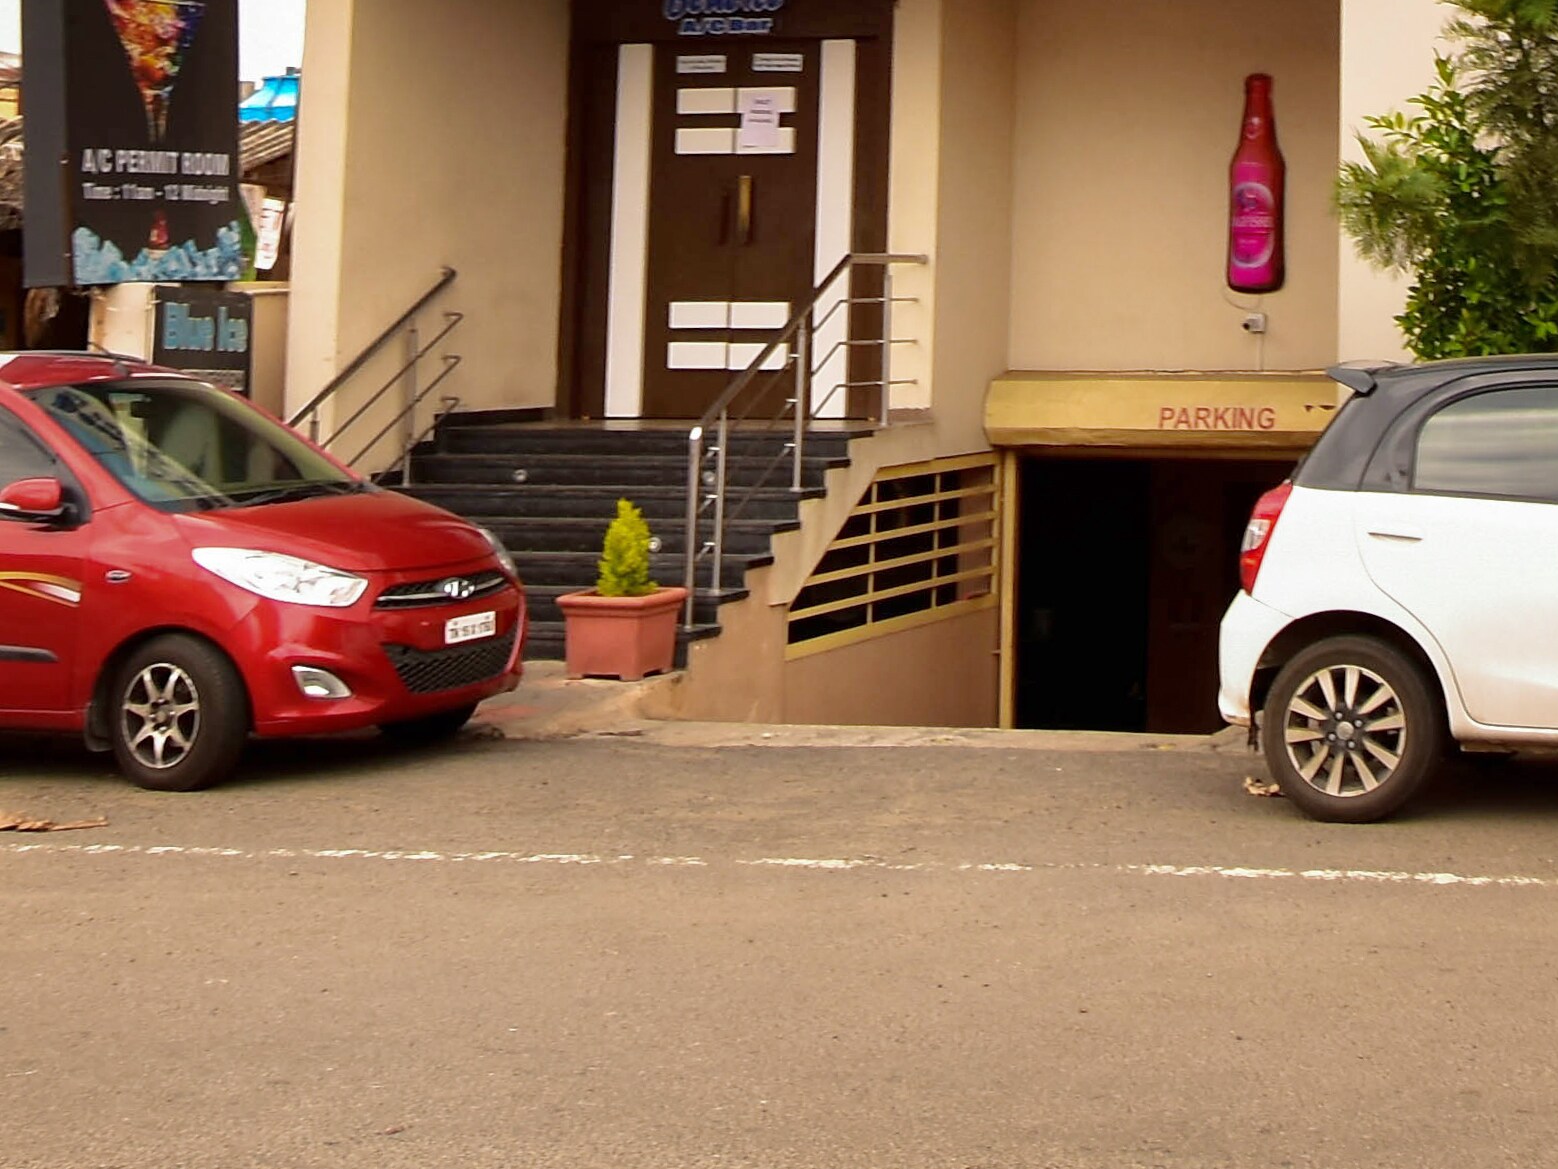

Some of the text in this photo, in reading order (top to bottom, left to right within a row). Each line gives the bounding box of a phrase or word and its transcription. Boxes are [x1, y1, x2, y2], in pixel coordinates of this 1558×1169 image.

[115, 149, 180, 175] PERMIT
[181, 151, 231, 177] ROOM
[1157, 406, 1277, 431] PARKING
